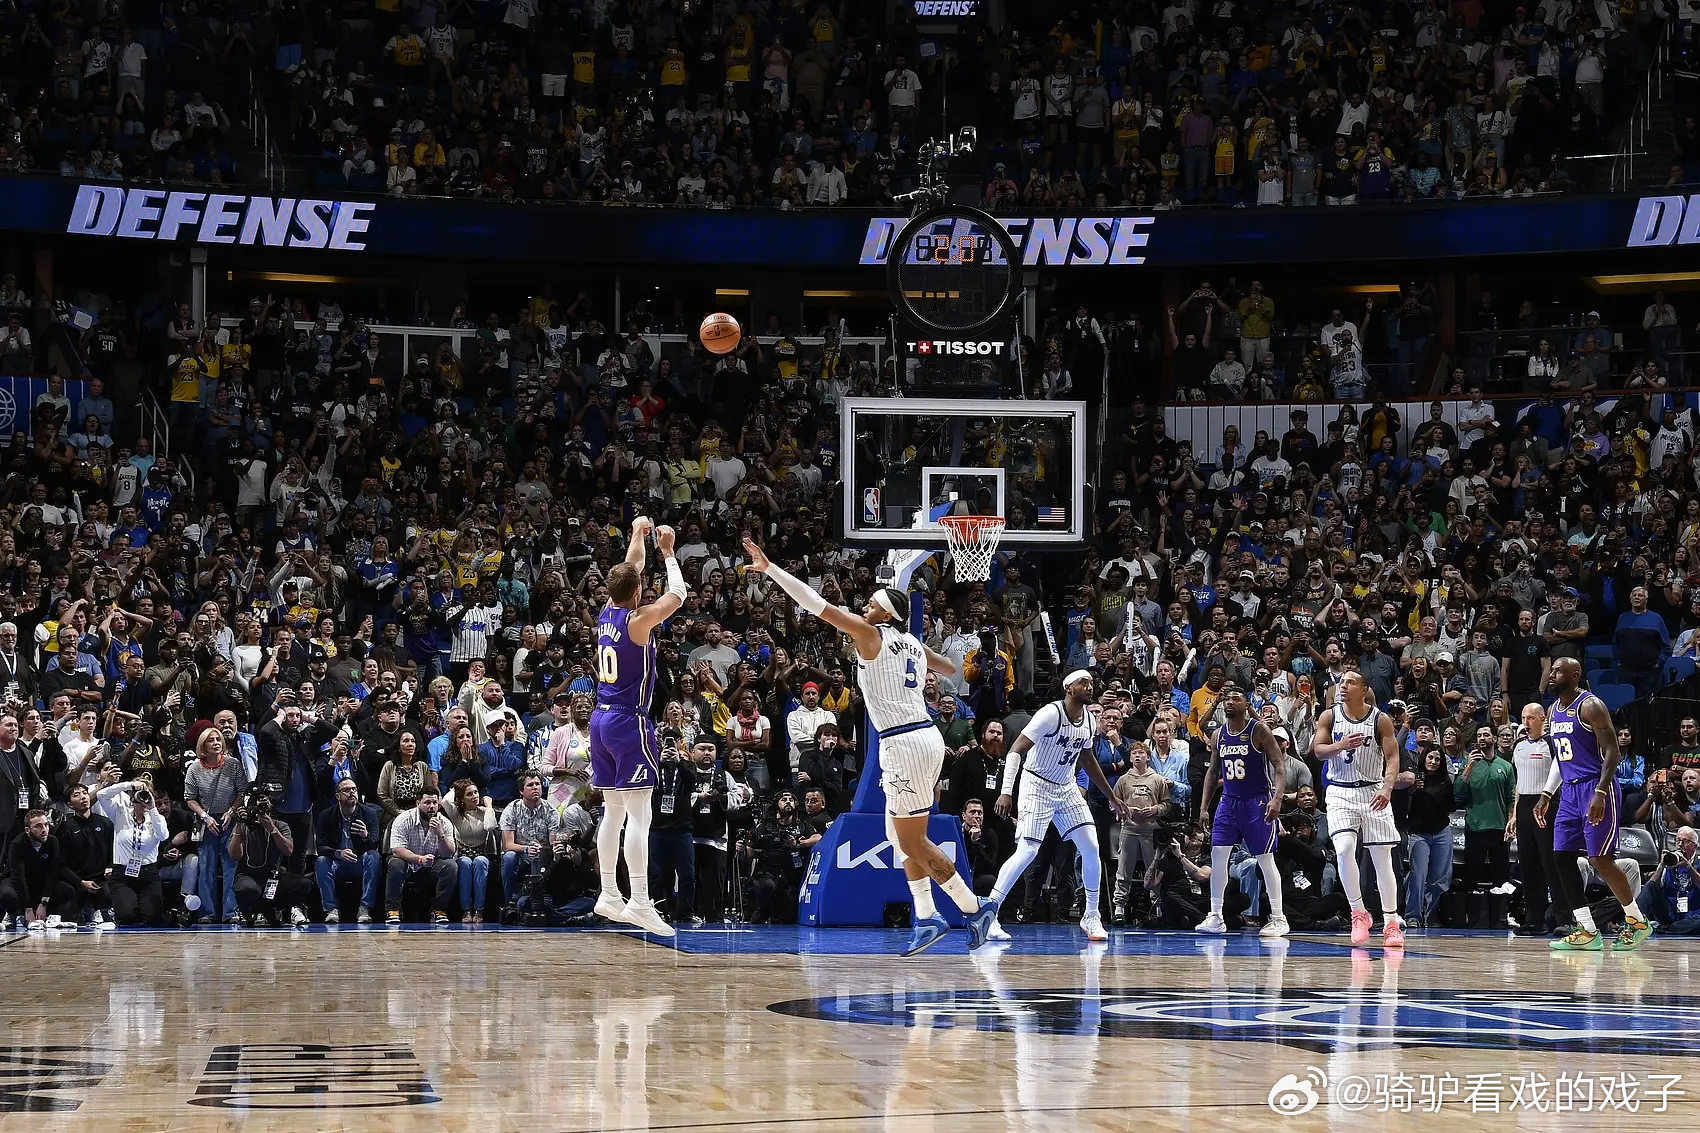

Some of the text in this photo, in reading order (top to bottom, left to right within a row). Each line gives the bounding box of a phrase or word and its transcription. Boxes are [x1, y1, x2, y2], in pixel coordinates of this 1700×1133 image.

[914, 0, 979, 16] DEFENS
[820, 21, 828, 30] 15
[1327, 16, 1333, 24] 5
[1427, 26, 1433, 36] 5
[617, 36, 629, 45] 23
[404, 52, 414, 61] 77
[1372, 56, 1384, 65] 23
[669, 62, 680, 71] 23
[1219, 136, 1229, 144] 77
[1256, 131, 1267, 142] 77
[1368, 162, 1381, 173] 23
[66, 184, 377, 251] DEFENSE
[102, 340, 114, 352] 50
[1341, 360, 1356, 371] 23
[180, 372, 194, 382] 23
[626, 433, 635, 444] 2
[123, 481, 131, 491] 8
[1343, 476, 1355, 486] 34
[253, 609, 269, 622] 24
[904, 658, 918, 689] 5
[1219, 743, 1249, 757] LAKERS
[1058, 750, 1079, 766] 34
[1344, 750, 1355, 764] 3
[628, 764, 649, 784] LA
[1223, 759, 1246, 781] 36
